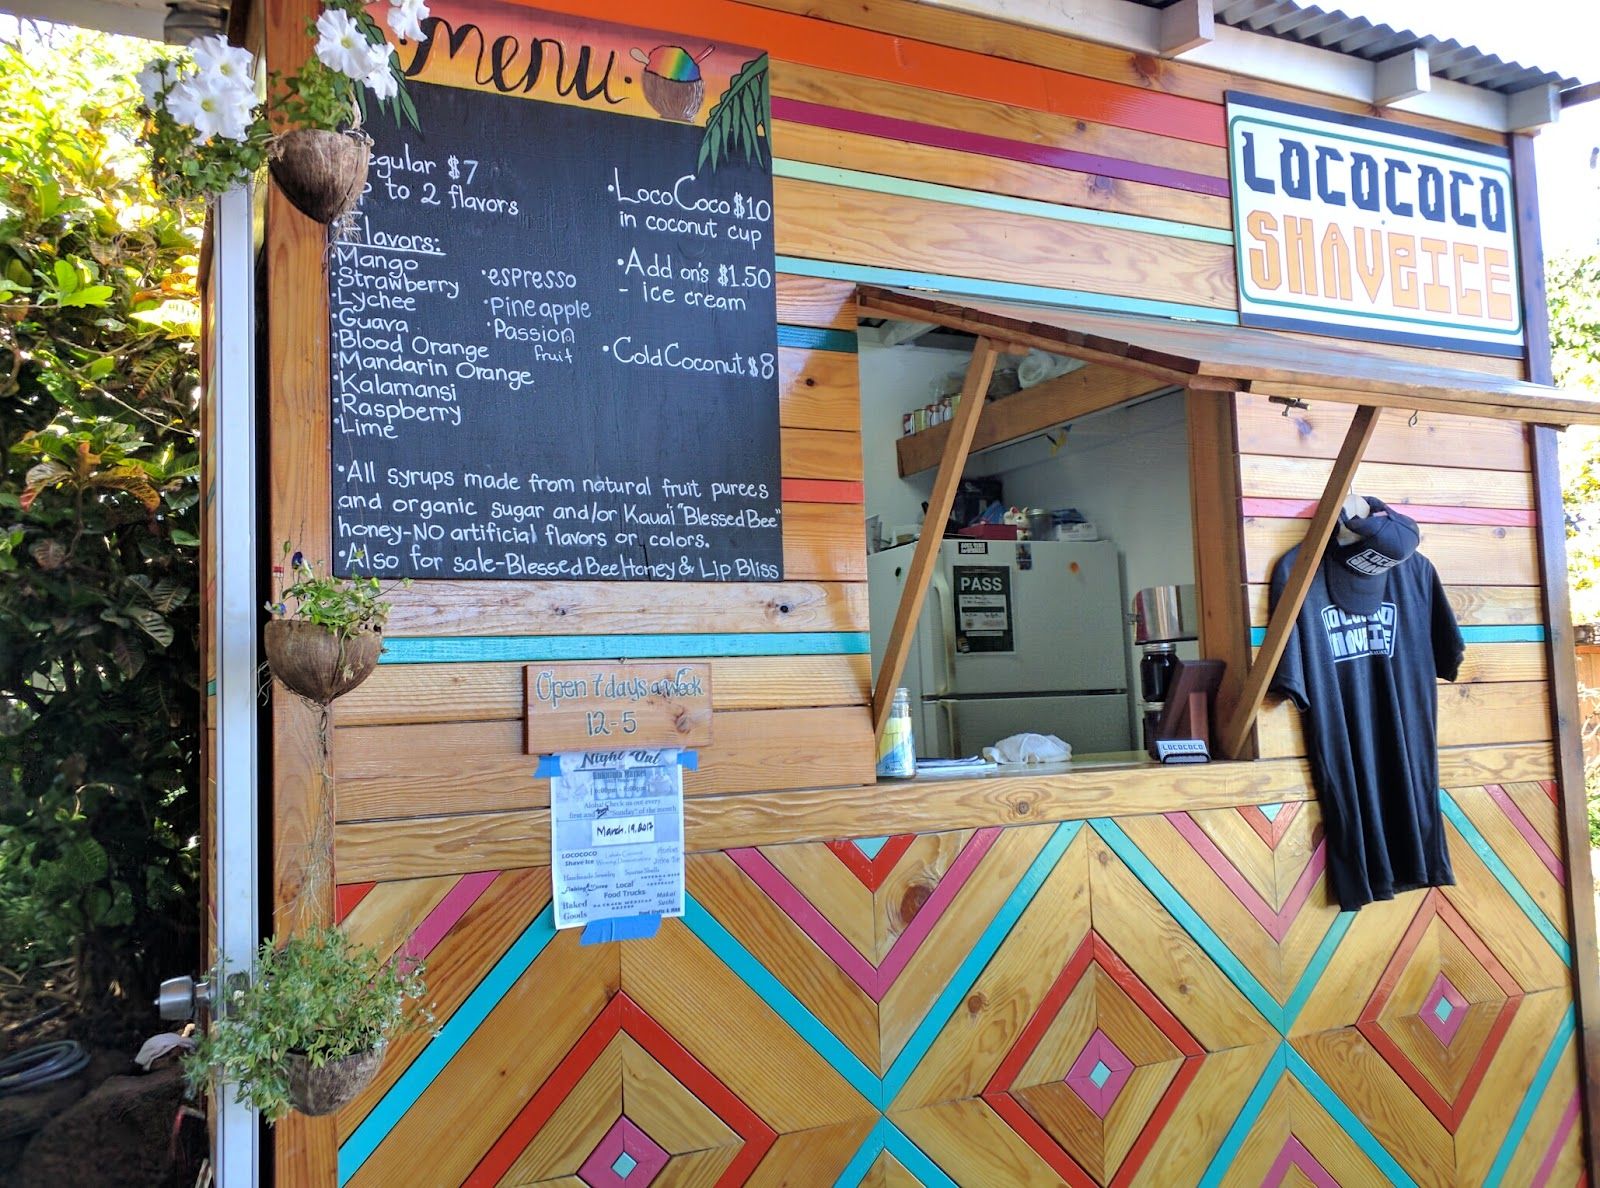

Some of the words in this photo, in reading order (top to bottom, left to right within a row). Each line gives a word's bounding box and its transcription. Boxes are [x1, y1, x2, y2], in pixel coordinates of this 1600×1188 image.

[368, 143, 437, 179] egular
[385, 177, 410, 200] to
[420, 182, 440, 205] 2
[448, 184, 519, 215] flavors
[1241, 131, 1507, 233] LOCOCOCO
[733, 191, 771, 222] $10
[619, 211, 637, 228] in
[646, 215, 718, 238] coconut
[727, 225, 762, 250] cup
[337, 246, 418, 278] Mango
[625, 247, 672, 279] Add
[717, 264, 771, 289] $1.50
[338, 266, 459, 299] Strawberry
[487, 267, 577, 289] espresso
[338, 287, 416, 312] Lychee
[490, 296, 592, 325] Pineapple
[684, 290, 746, 311] cream
[339, 307, 408, 332] Guava
[494, 318, 575, 343] Passion
[339, 329, 403, 353] Blood
[412, 335, 489, 362] Orange
[534, 344, 573, 363] fruit
[339, 350, 448, 376] Mandarin
[456, 362, 535, 390] Orange
[748, 353, 775, 380] $8
[339, 370, 456, 402] Kalamansi
[341, 393, 461, 426] Raspberry
[339, 413, 398, 439] Lime
[346, 459, 376, 484] All
[387, 467, 455, 490] syrups
[464, 472, 521, 490] made
[528, 473, 575, 492] from
[582, 476, 652, 496] natural
[662, 478, 702, 498] fruit
[711, 481, 769, 502] purees
[338, 492, 382, 510] and
[392, 497, 477, 519] organic
[491, 501, 544, 523] sugar
[552, 501, 617, 523] and/or
[450, 522, 537, 545] artificial
[545, 523, 607, 546] flavors
[615, 532, 638, 546] or
[649, 531, 710, 548] colors.
[344, 541, 399, 570] Also
[410, 544, 443, 570] for
[679, 555, 694, 576] &
[700, 557, 731, 581] Lip
[733, 558, 779, 579] Bliss
[960, 577, 1002, 591] PASS
[536, 670, 588, 708] Open
[592, 672, 603, 698] 7
[604, 673, 647, 704] days
[580, 751, 627, 769] Night
[565, 859, 584, 867] Shave
[604, 891, 621, 899] Food
[622, 889, 647, 898] Trucks
[616, 880, 634, 889] Local
[563, 899, 588, 910] Baked
